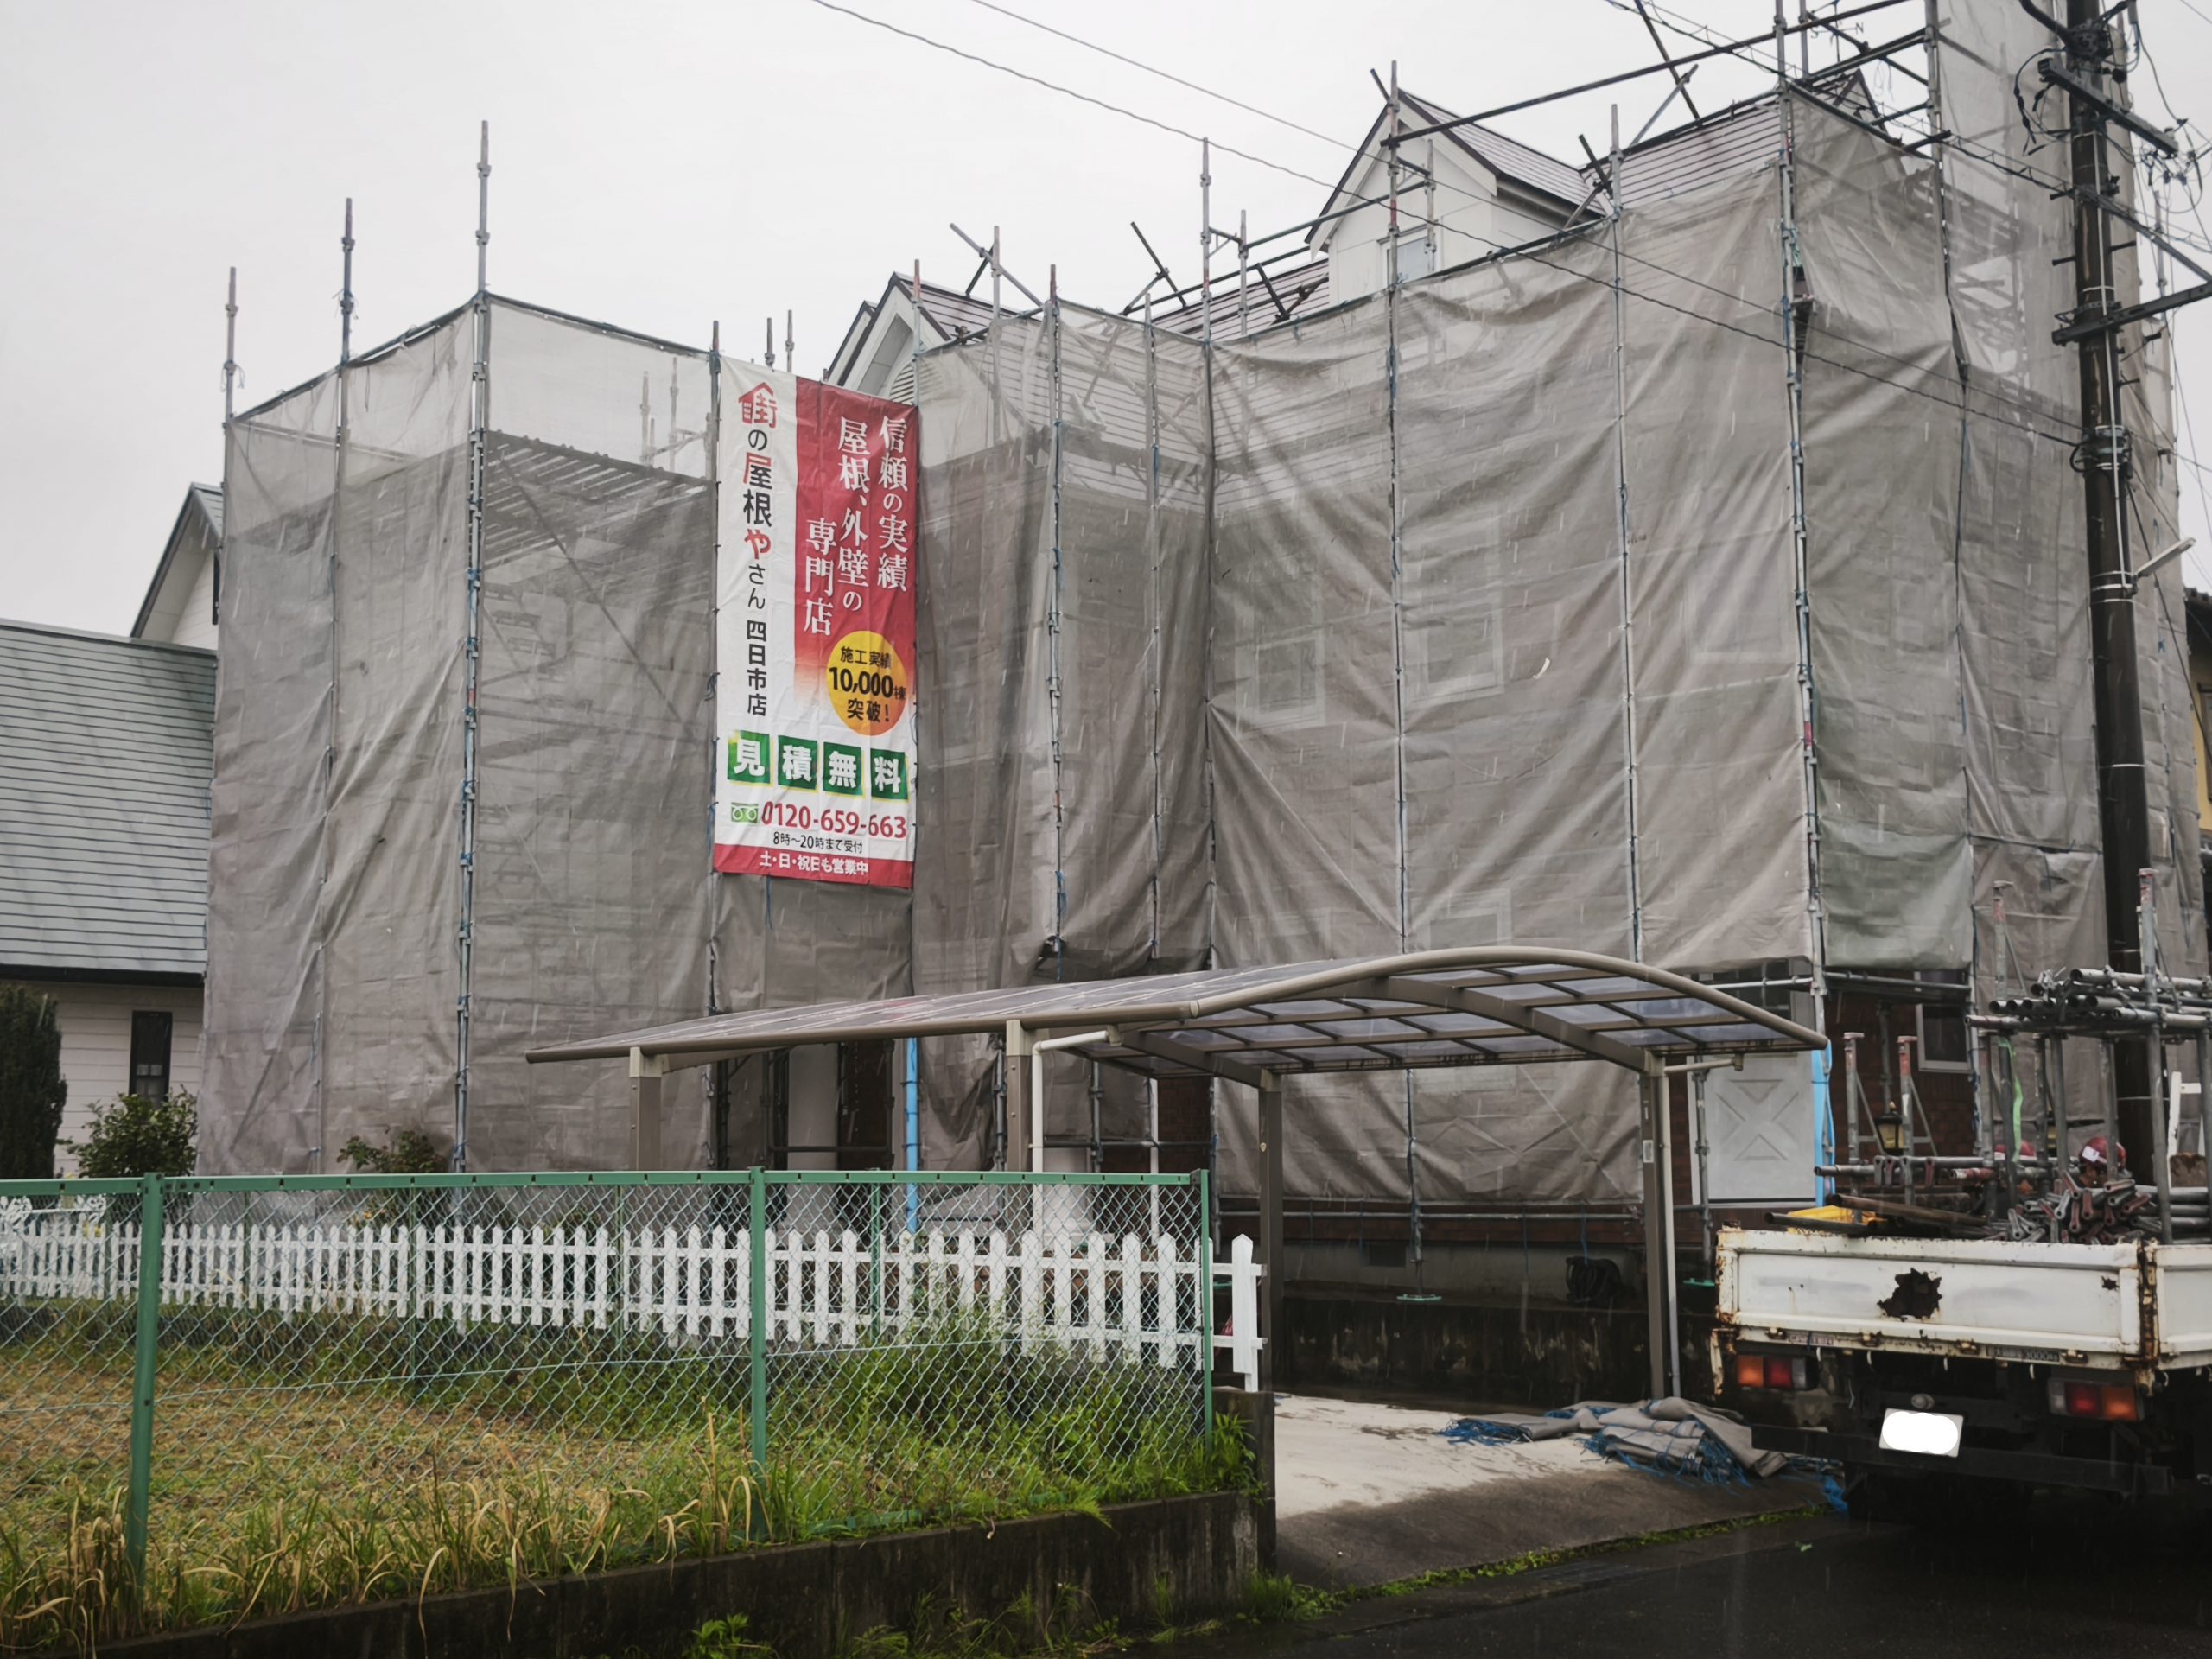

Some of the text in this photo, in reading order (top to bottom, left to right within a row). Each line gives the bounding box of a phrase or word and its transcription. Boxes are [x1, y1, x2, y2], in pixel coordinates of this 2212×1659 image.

[1855, 22, 1864, 35] N
[837, 416, 871, 612] 屋根、外壁の
[877, 416, 909, 592] 信頼の実績
[738, 382, 778, 716] 街の屋根やさん 四日市店
[804, 518, 837, 636] 専門店
[840, 645, 892, 670] 施工実績
[734, 738, 902, 793] 見積無料
[761, 801, 907, 839] 0120-659-663
